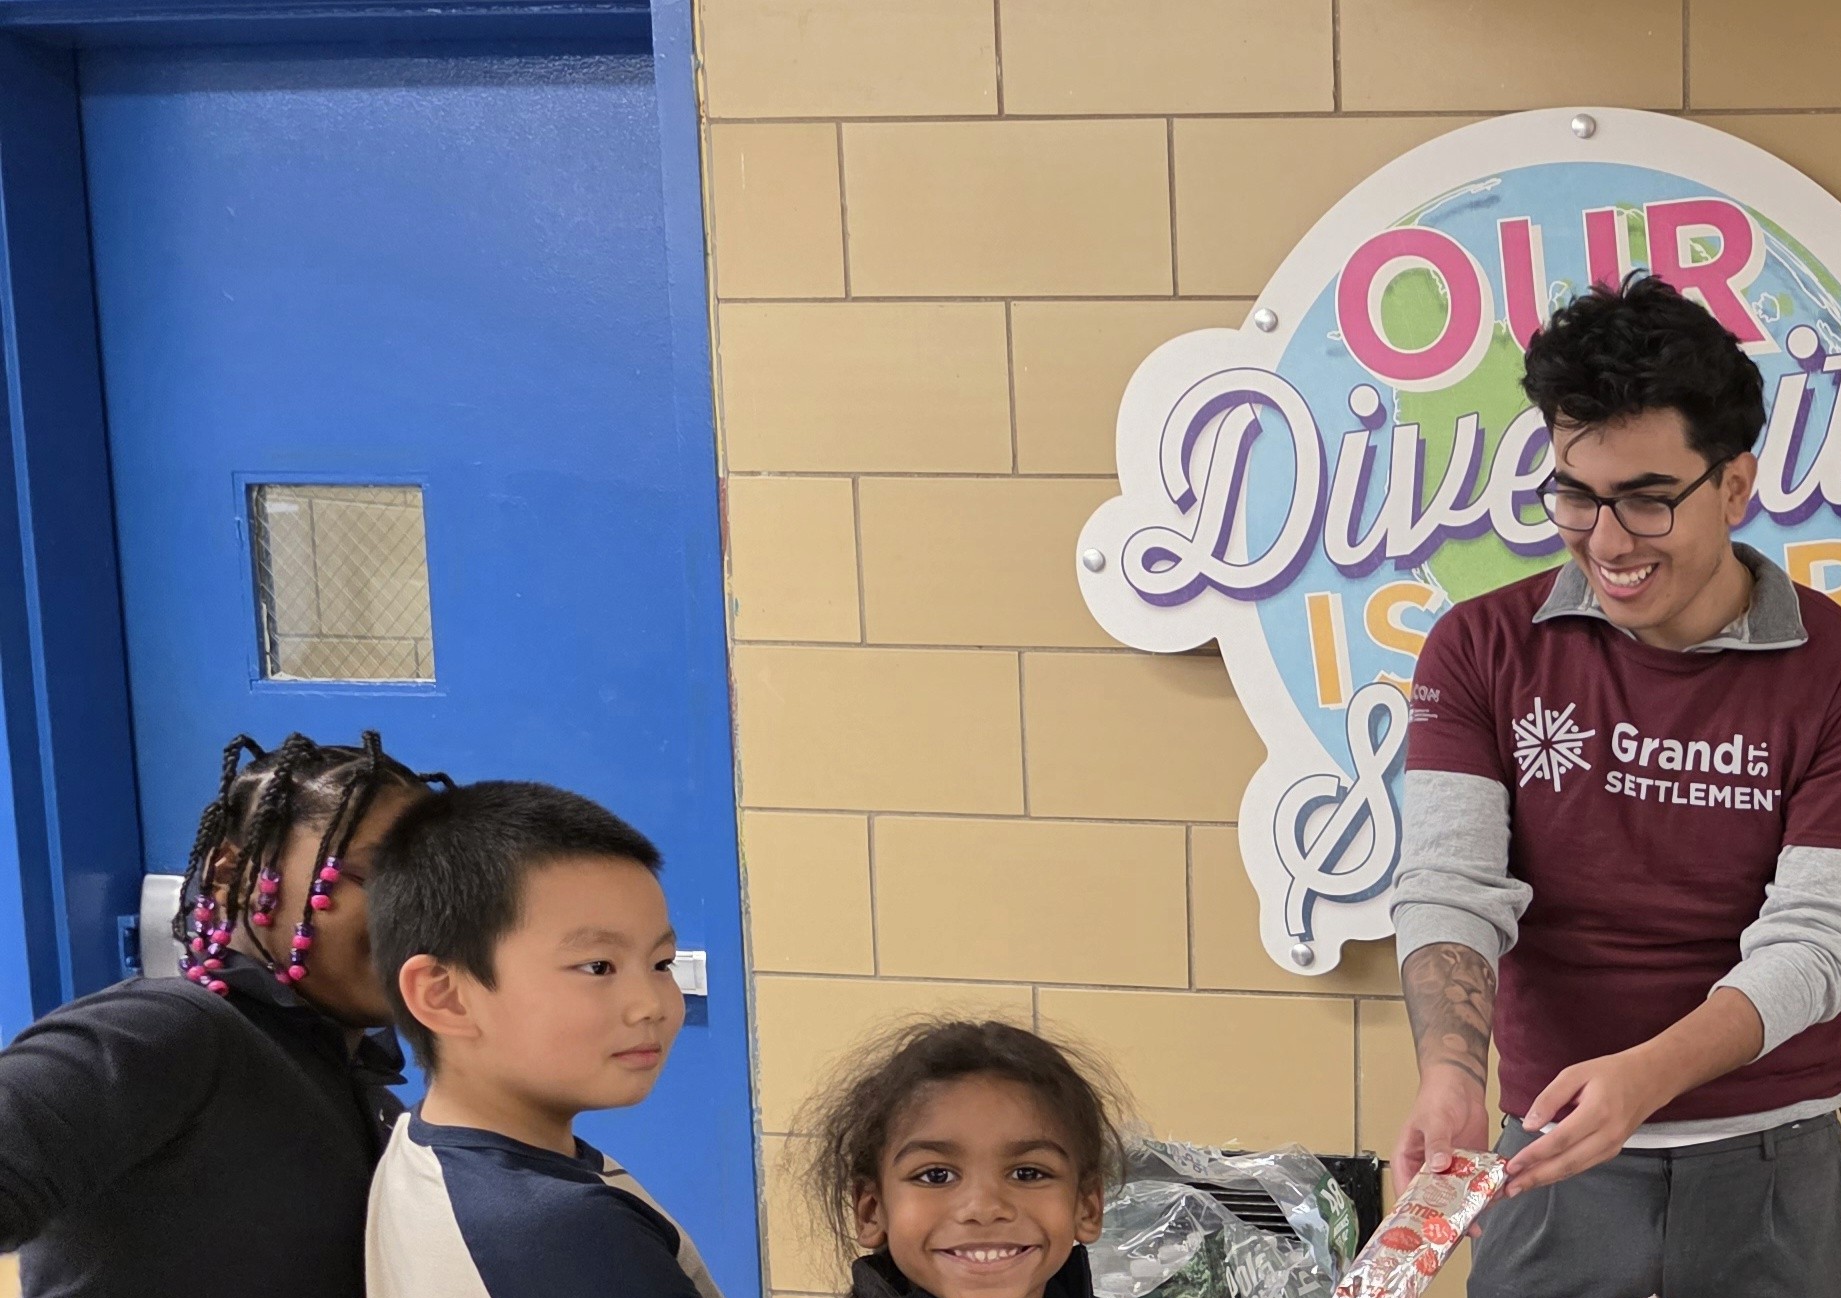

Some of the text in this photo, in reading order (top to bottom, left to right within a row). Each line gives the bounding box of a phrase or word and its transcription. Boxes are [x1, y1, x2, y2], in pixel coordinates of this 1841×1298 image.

[1336, 196, 1781, 390] OUR
[1612, 722, 1769, 778] Grand ST.
